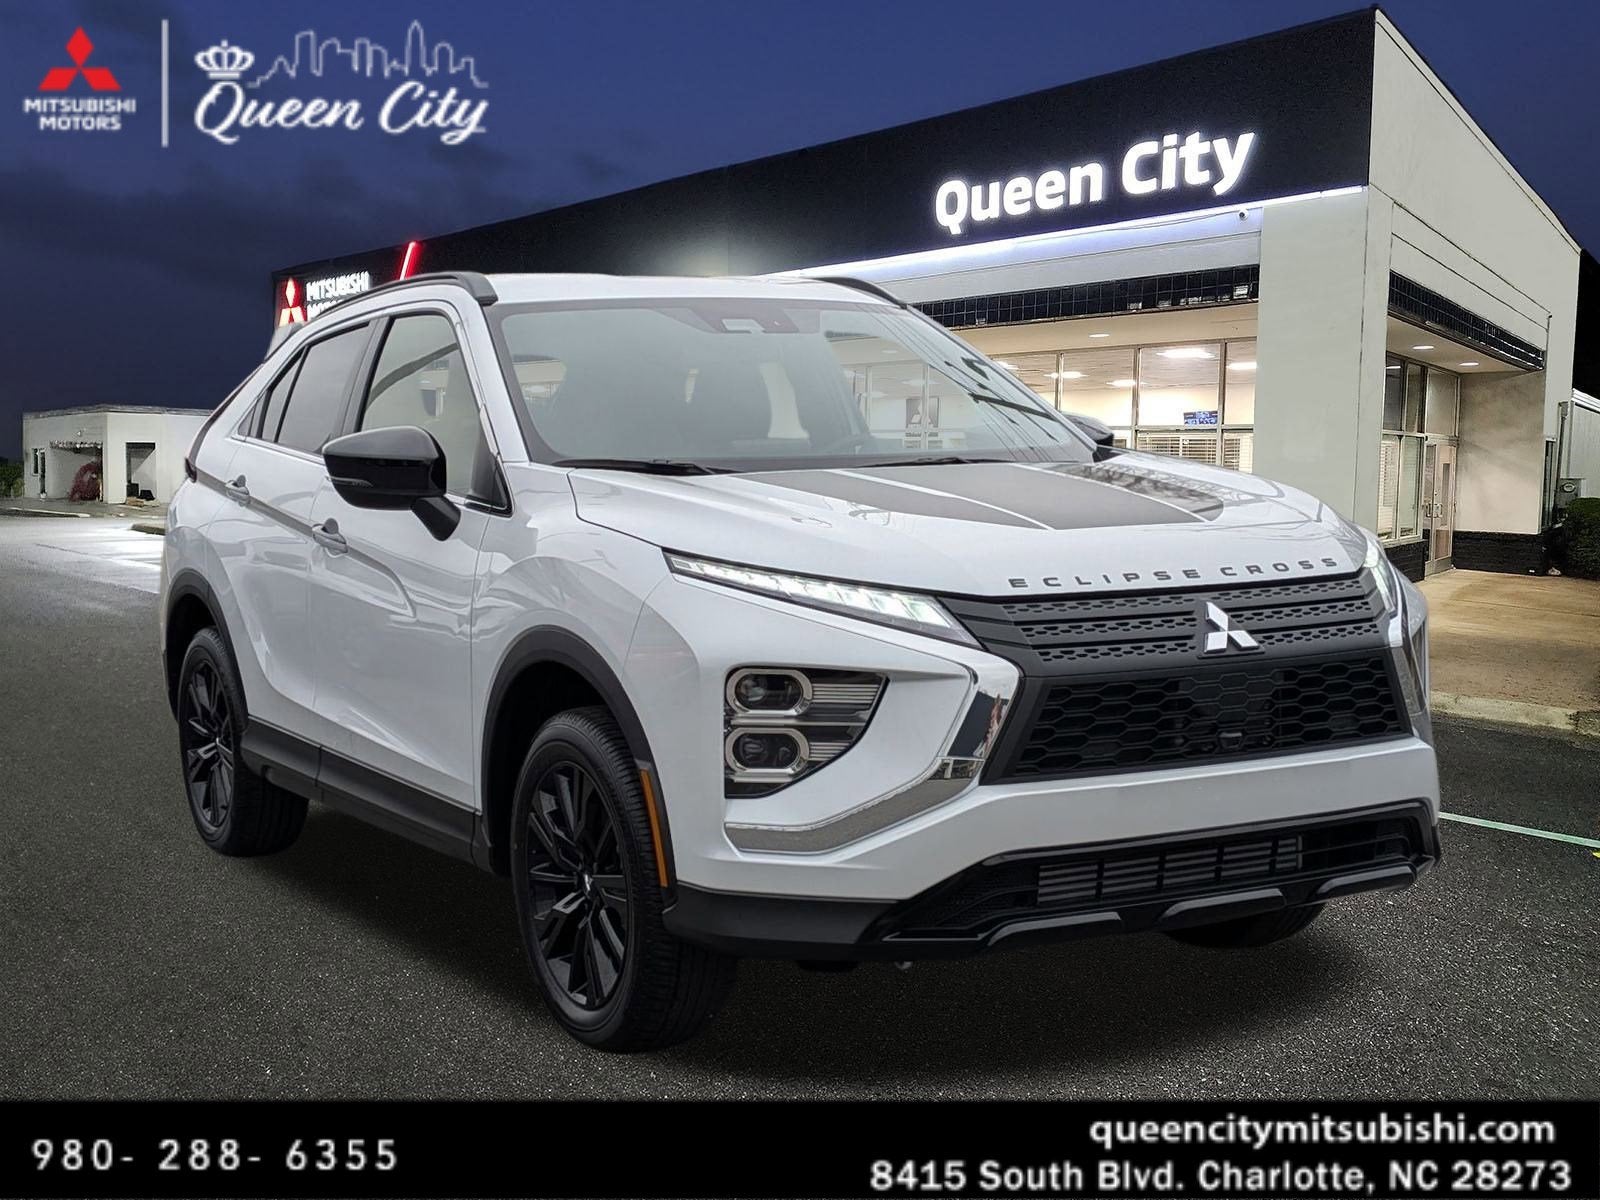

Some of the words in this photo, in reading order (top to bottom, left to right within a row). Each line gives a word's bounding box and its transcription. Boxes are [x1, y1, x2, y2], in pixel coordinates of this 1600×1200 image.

[935, 162, 1104, 234] Queen
[1122, 131, 1256, 195] City
[306, 271, 370, 302] MITSUBISHI
[1009, 568, 1201, 589] ECLIPSE
[1220, 557, 1338, 578] CROSS
